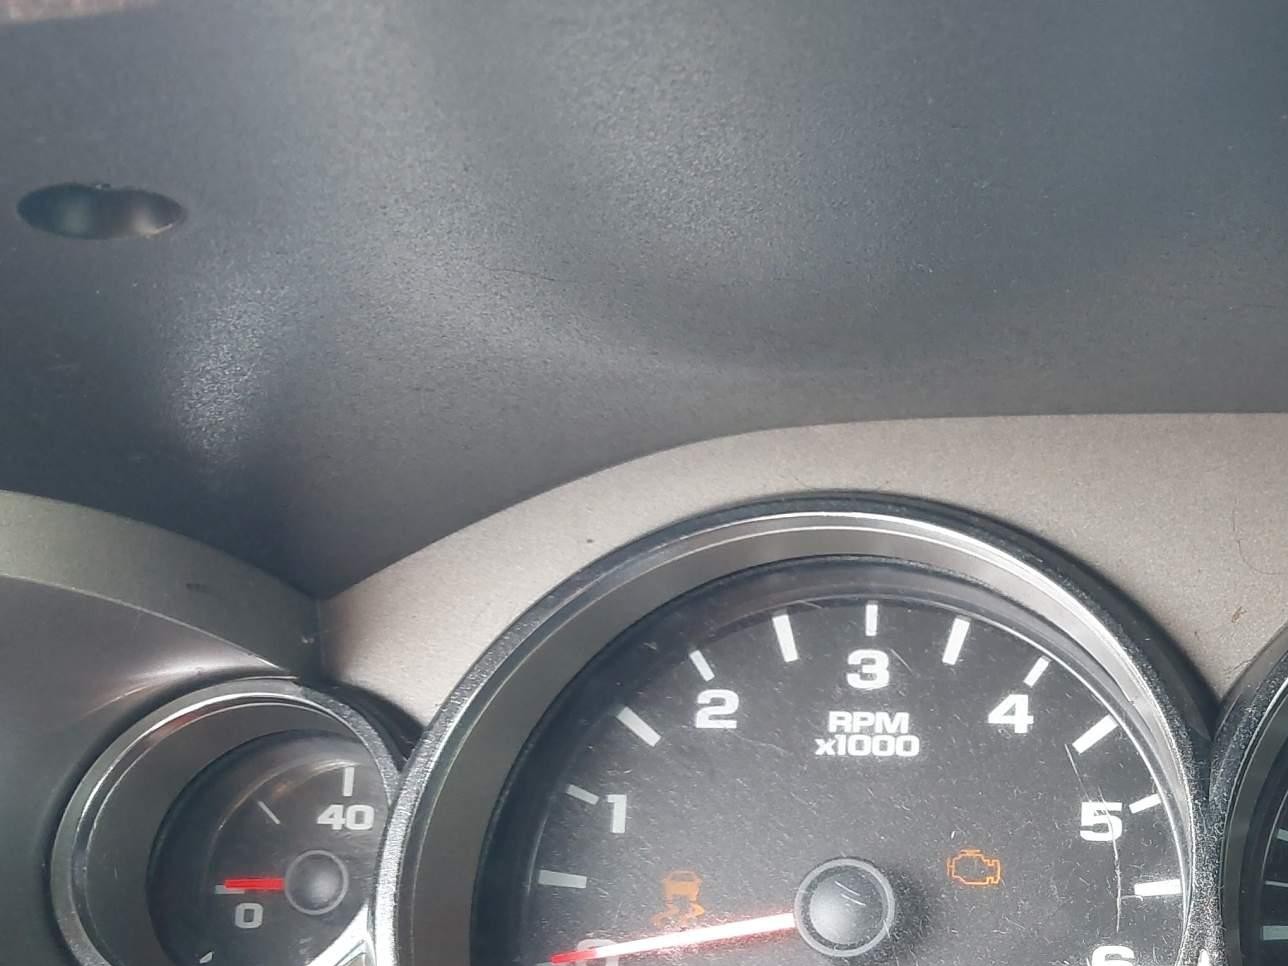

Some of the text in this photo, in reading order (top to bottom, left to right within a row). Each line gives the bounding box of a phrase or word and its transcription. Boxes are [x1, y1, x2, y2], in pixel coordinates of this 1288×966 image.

[846, 649, 890, 690] 3
[694, 690, 739, 729] 2
[828, 711, 909, 734] RPM
[987, 694, 1034, 733] 4
[815, 734, 920, 757] x1000
[317, 804, 374, 831] 40
[606, 794, 626, 833] 1
[1079, 801, 1123, 842] 5
[234, 902, 263, 929] 0
